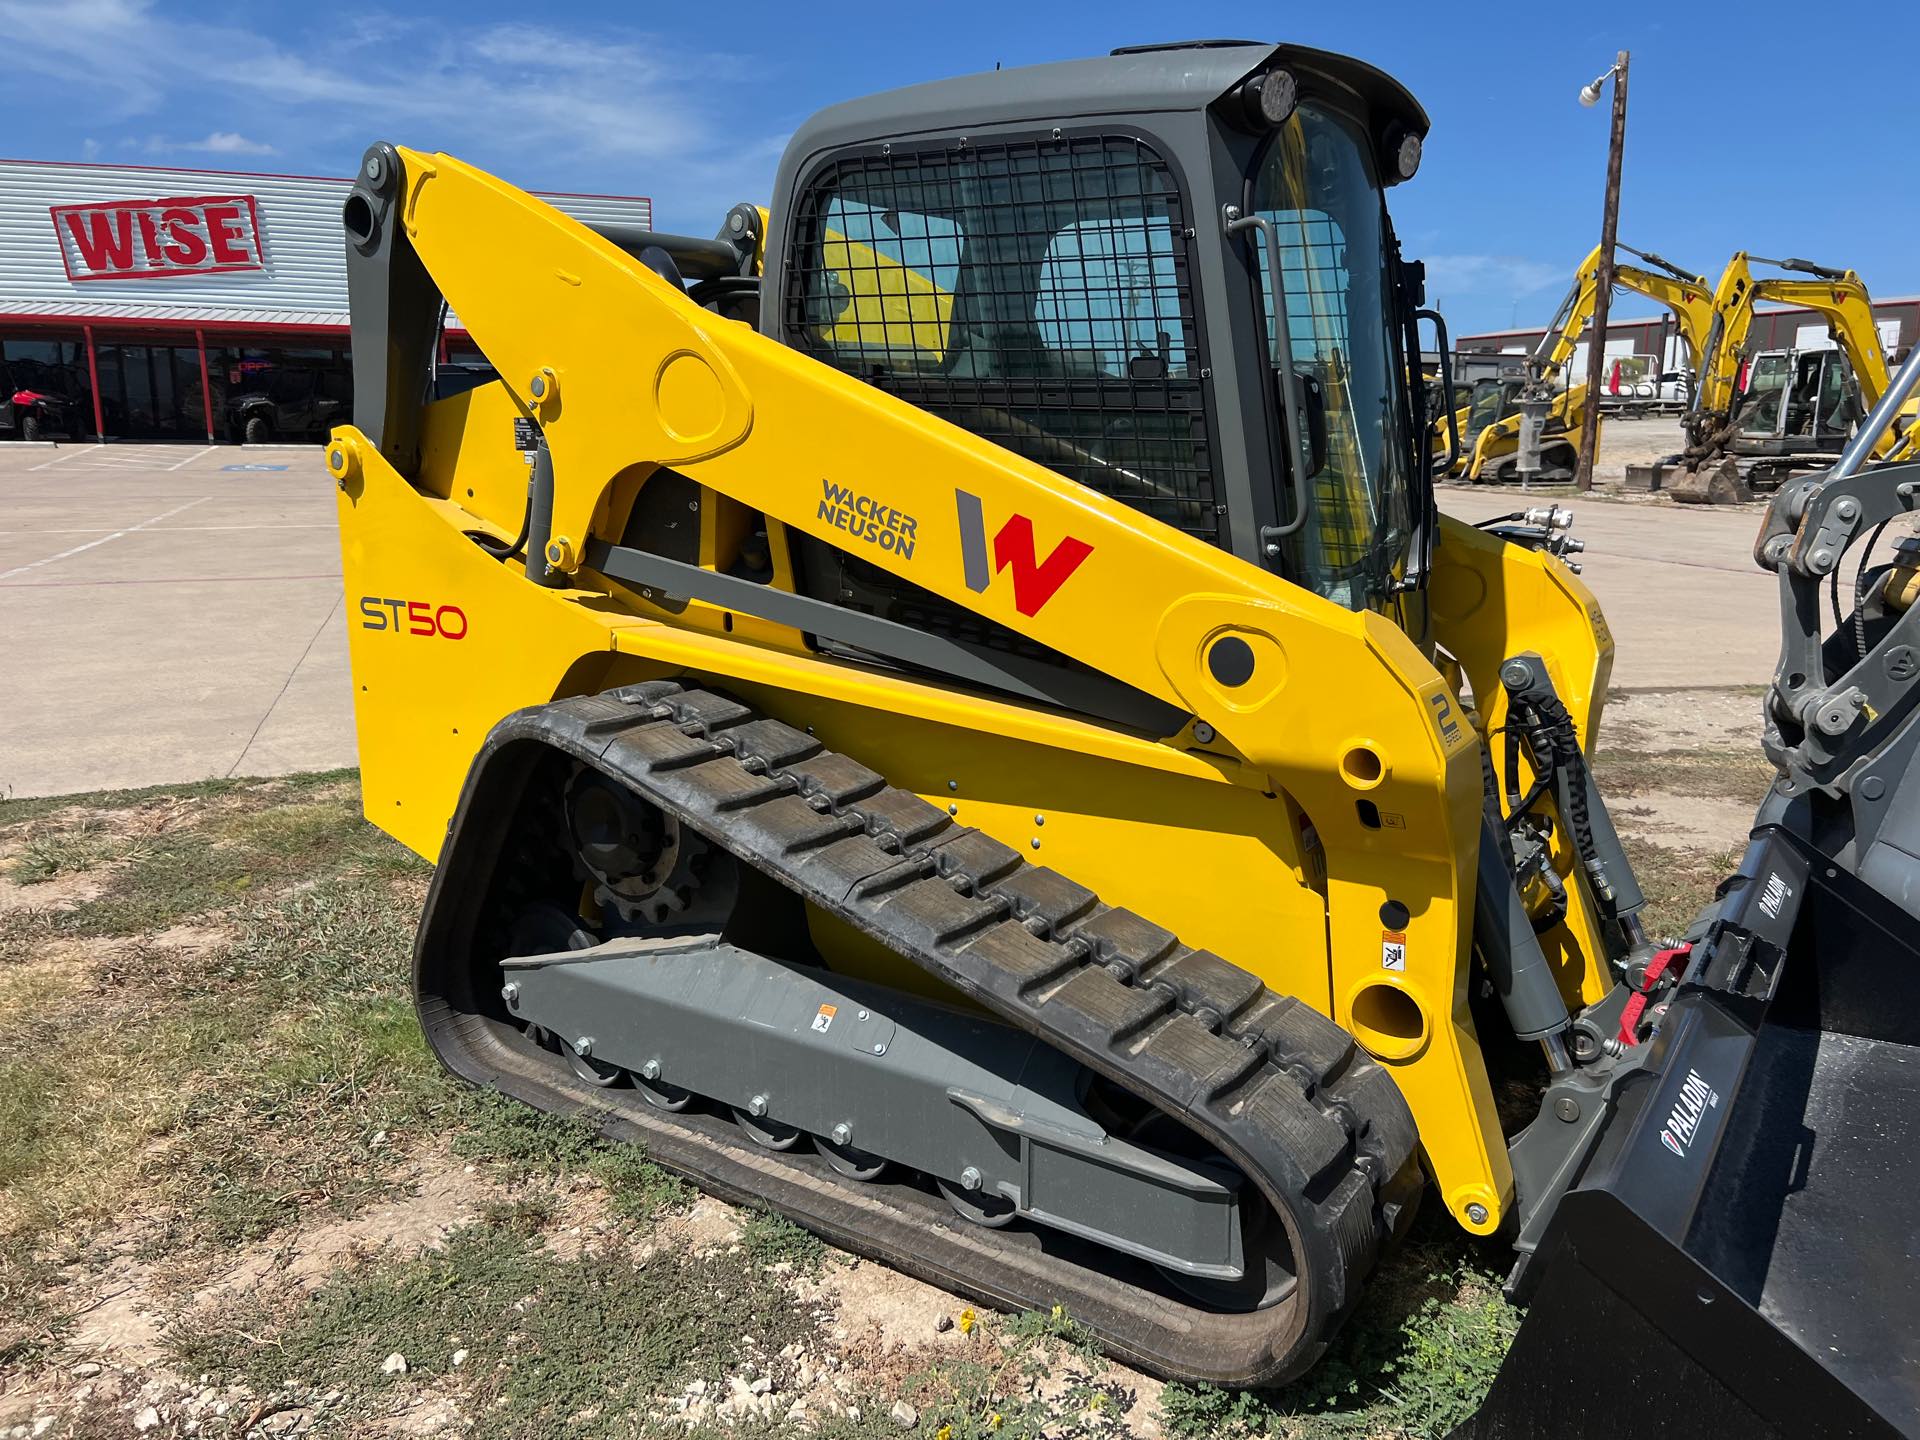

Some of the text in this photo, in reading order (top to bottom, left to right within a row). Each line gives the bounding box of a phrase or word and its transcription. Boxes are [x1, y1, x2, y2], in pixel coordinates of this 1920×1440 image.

[64, 207, 250, 272] WISE
[816, 500, 915, 561] NEUSON
[822, 478, 918, 539] WACKER
[360, 596, 468, 640] ST50
[1431, 693, 1458, 736] 2
[1762, 871, 1786, 913] PALADIN
[1666, 1068, 1710, 1145] PALADIN
